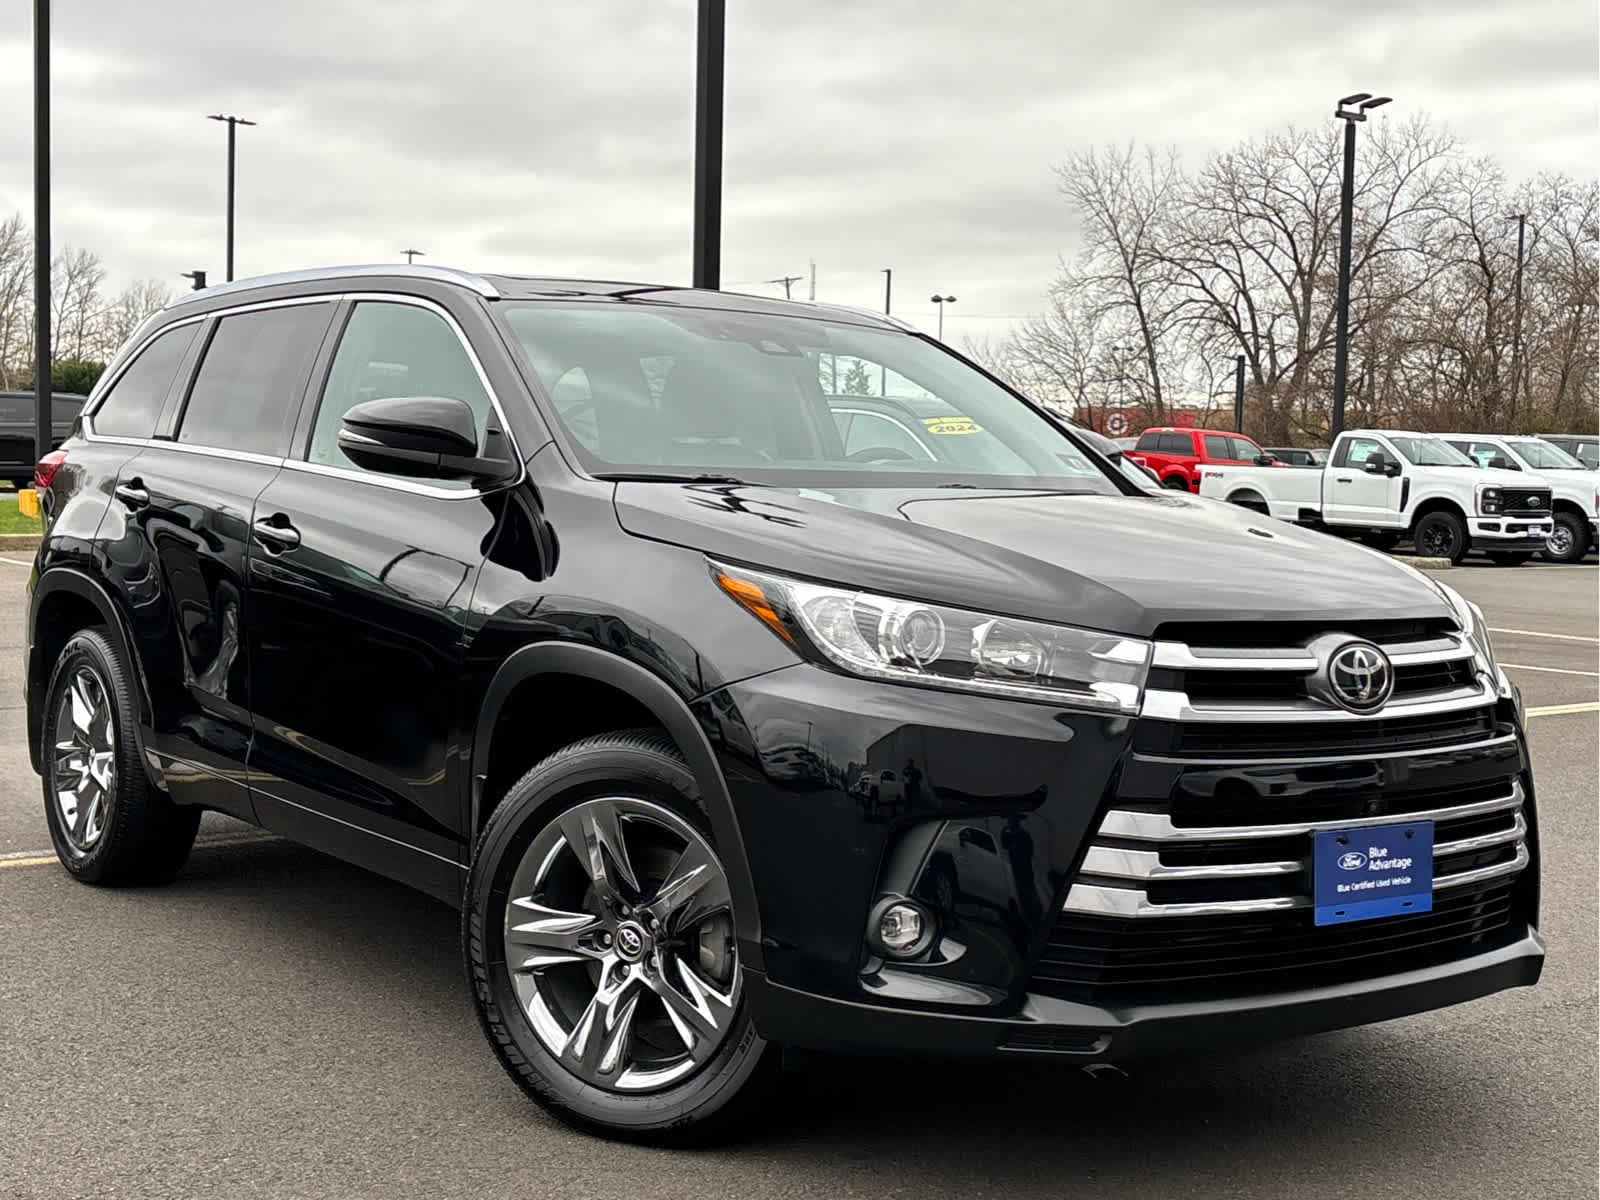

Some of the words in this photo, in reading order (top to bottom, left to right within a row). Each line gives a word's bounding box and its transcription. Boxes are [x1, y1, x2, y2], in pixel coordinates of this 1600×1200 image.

[1369, 847, 1388, 858] Blue
[1368, 858, 1412, 871] Advantage
[1337, 884, 1351, 892] Blue
[1391, 877, 1412, 885] Vehicle
